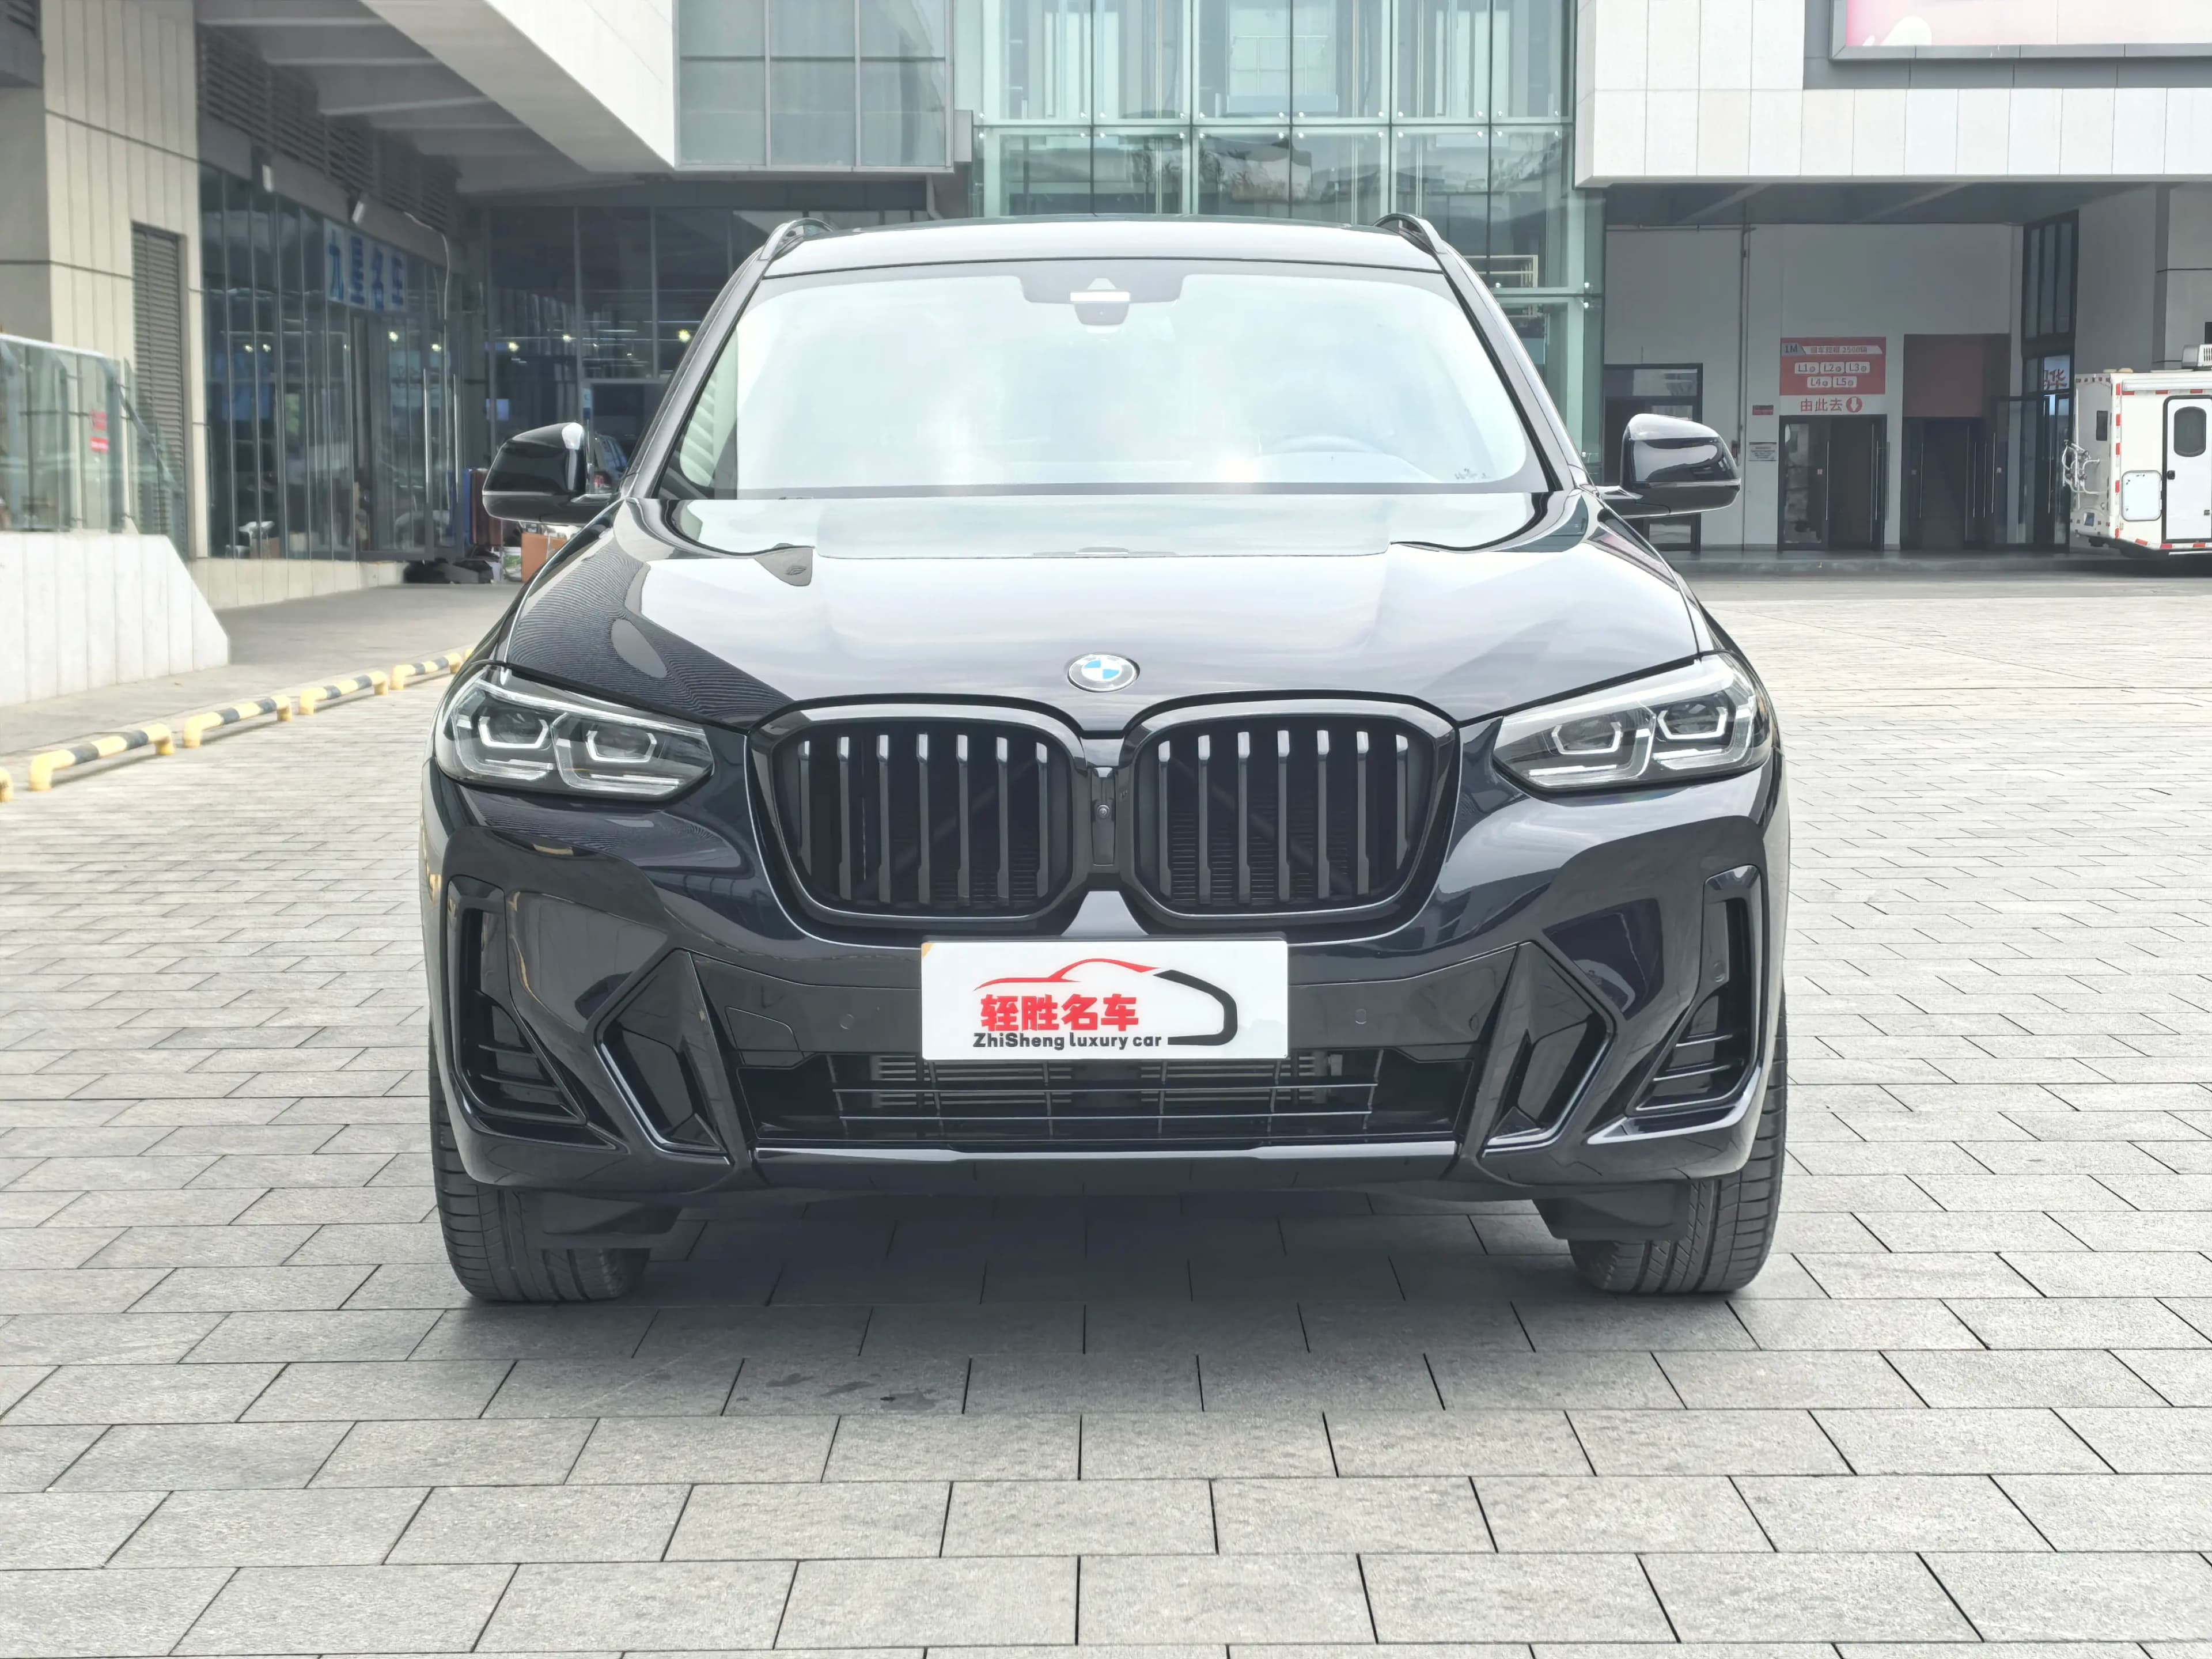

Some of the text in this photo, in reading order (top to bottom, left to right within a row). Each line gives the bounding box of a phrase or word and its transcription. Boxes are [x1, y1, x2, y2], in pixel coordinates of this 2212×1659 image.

[1801, 397, 1843, 412] 由此去
[980, 994, 1139, 1032] 轾胜名车
[973, 1032, 1162, 1051] ZhiSheng luxury car
